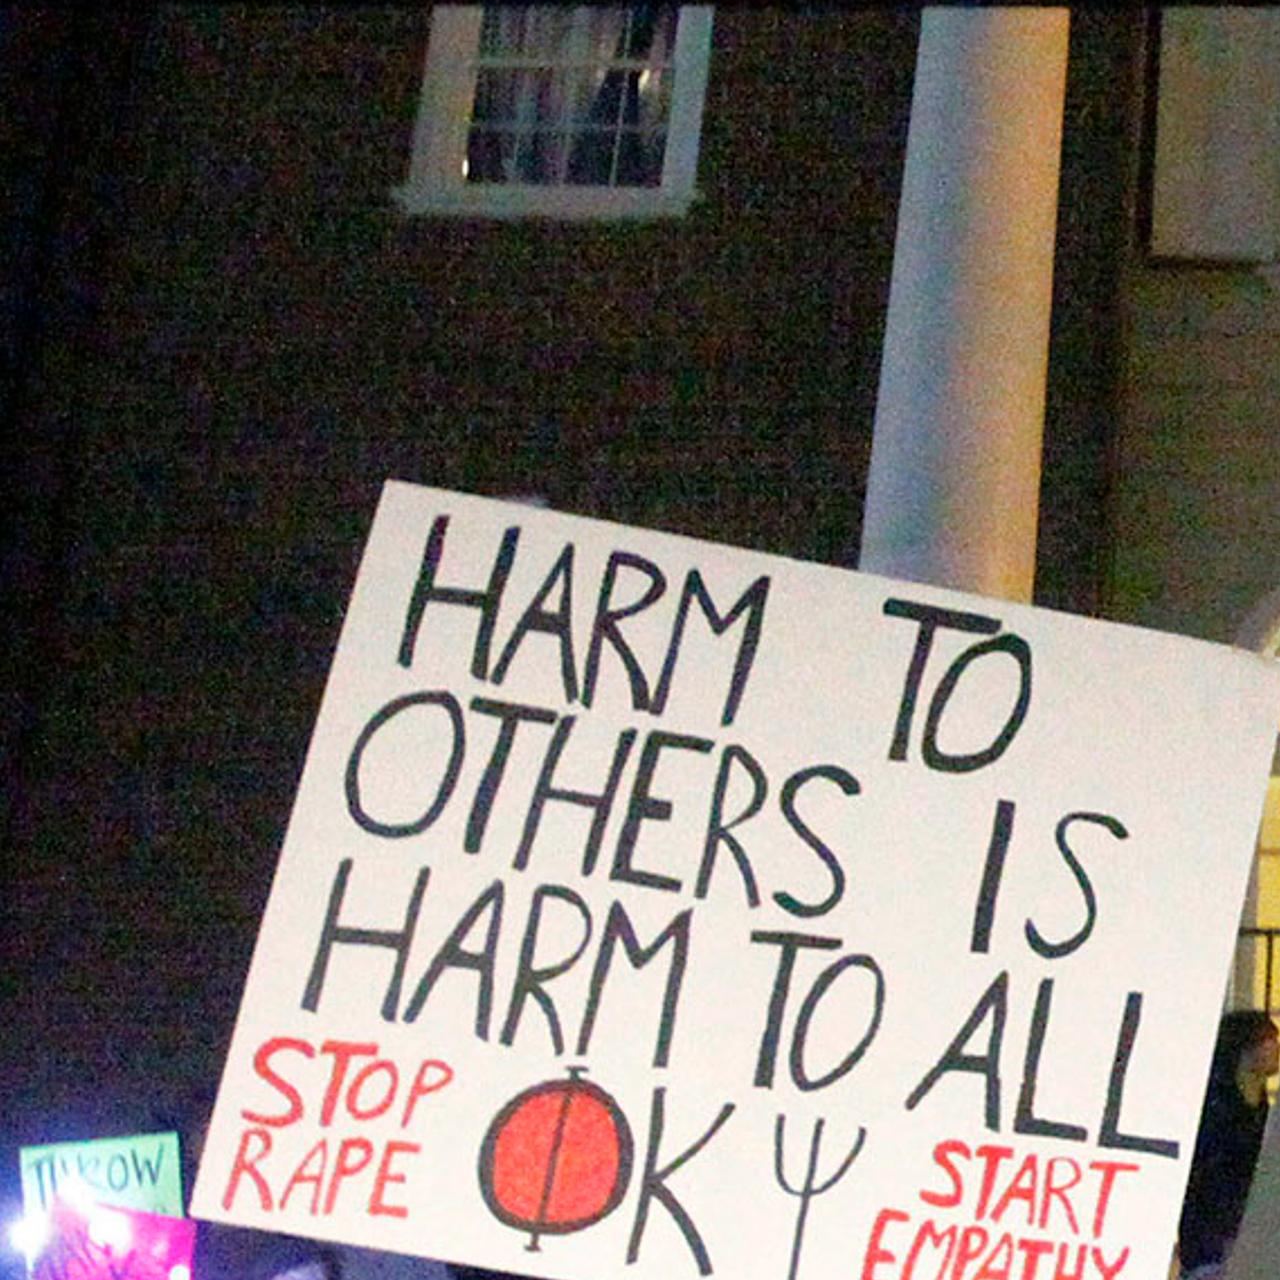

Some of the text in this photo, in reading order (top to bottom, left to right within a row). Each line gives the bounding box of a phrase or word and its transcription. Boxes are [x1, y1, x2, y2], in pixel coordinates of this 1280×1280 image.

[399, 514, 1031, 771] HARM TO
[344, 690, 1128, 959] OTHERS IS
[241, 1036, 453, 1130] STOP
[301, 858, 1180, 1157] HARM TO ALL
[224, 1128, 421, 1218] RAPE
[922, 1141, 1139, 1239] START
